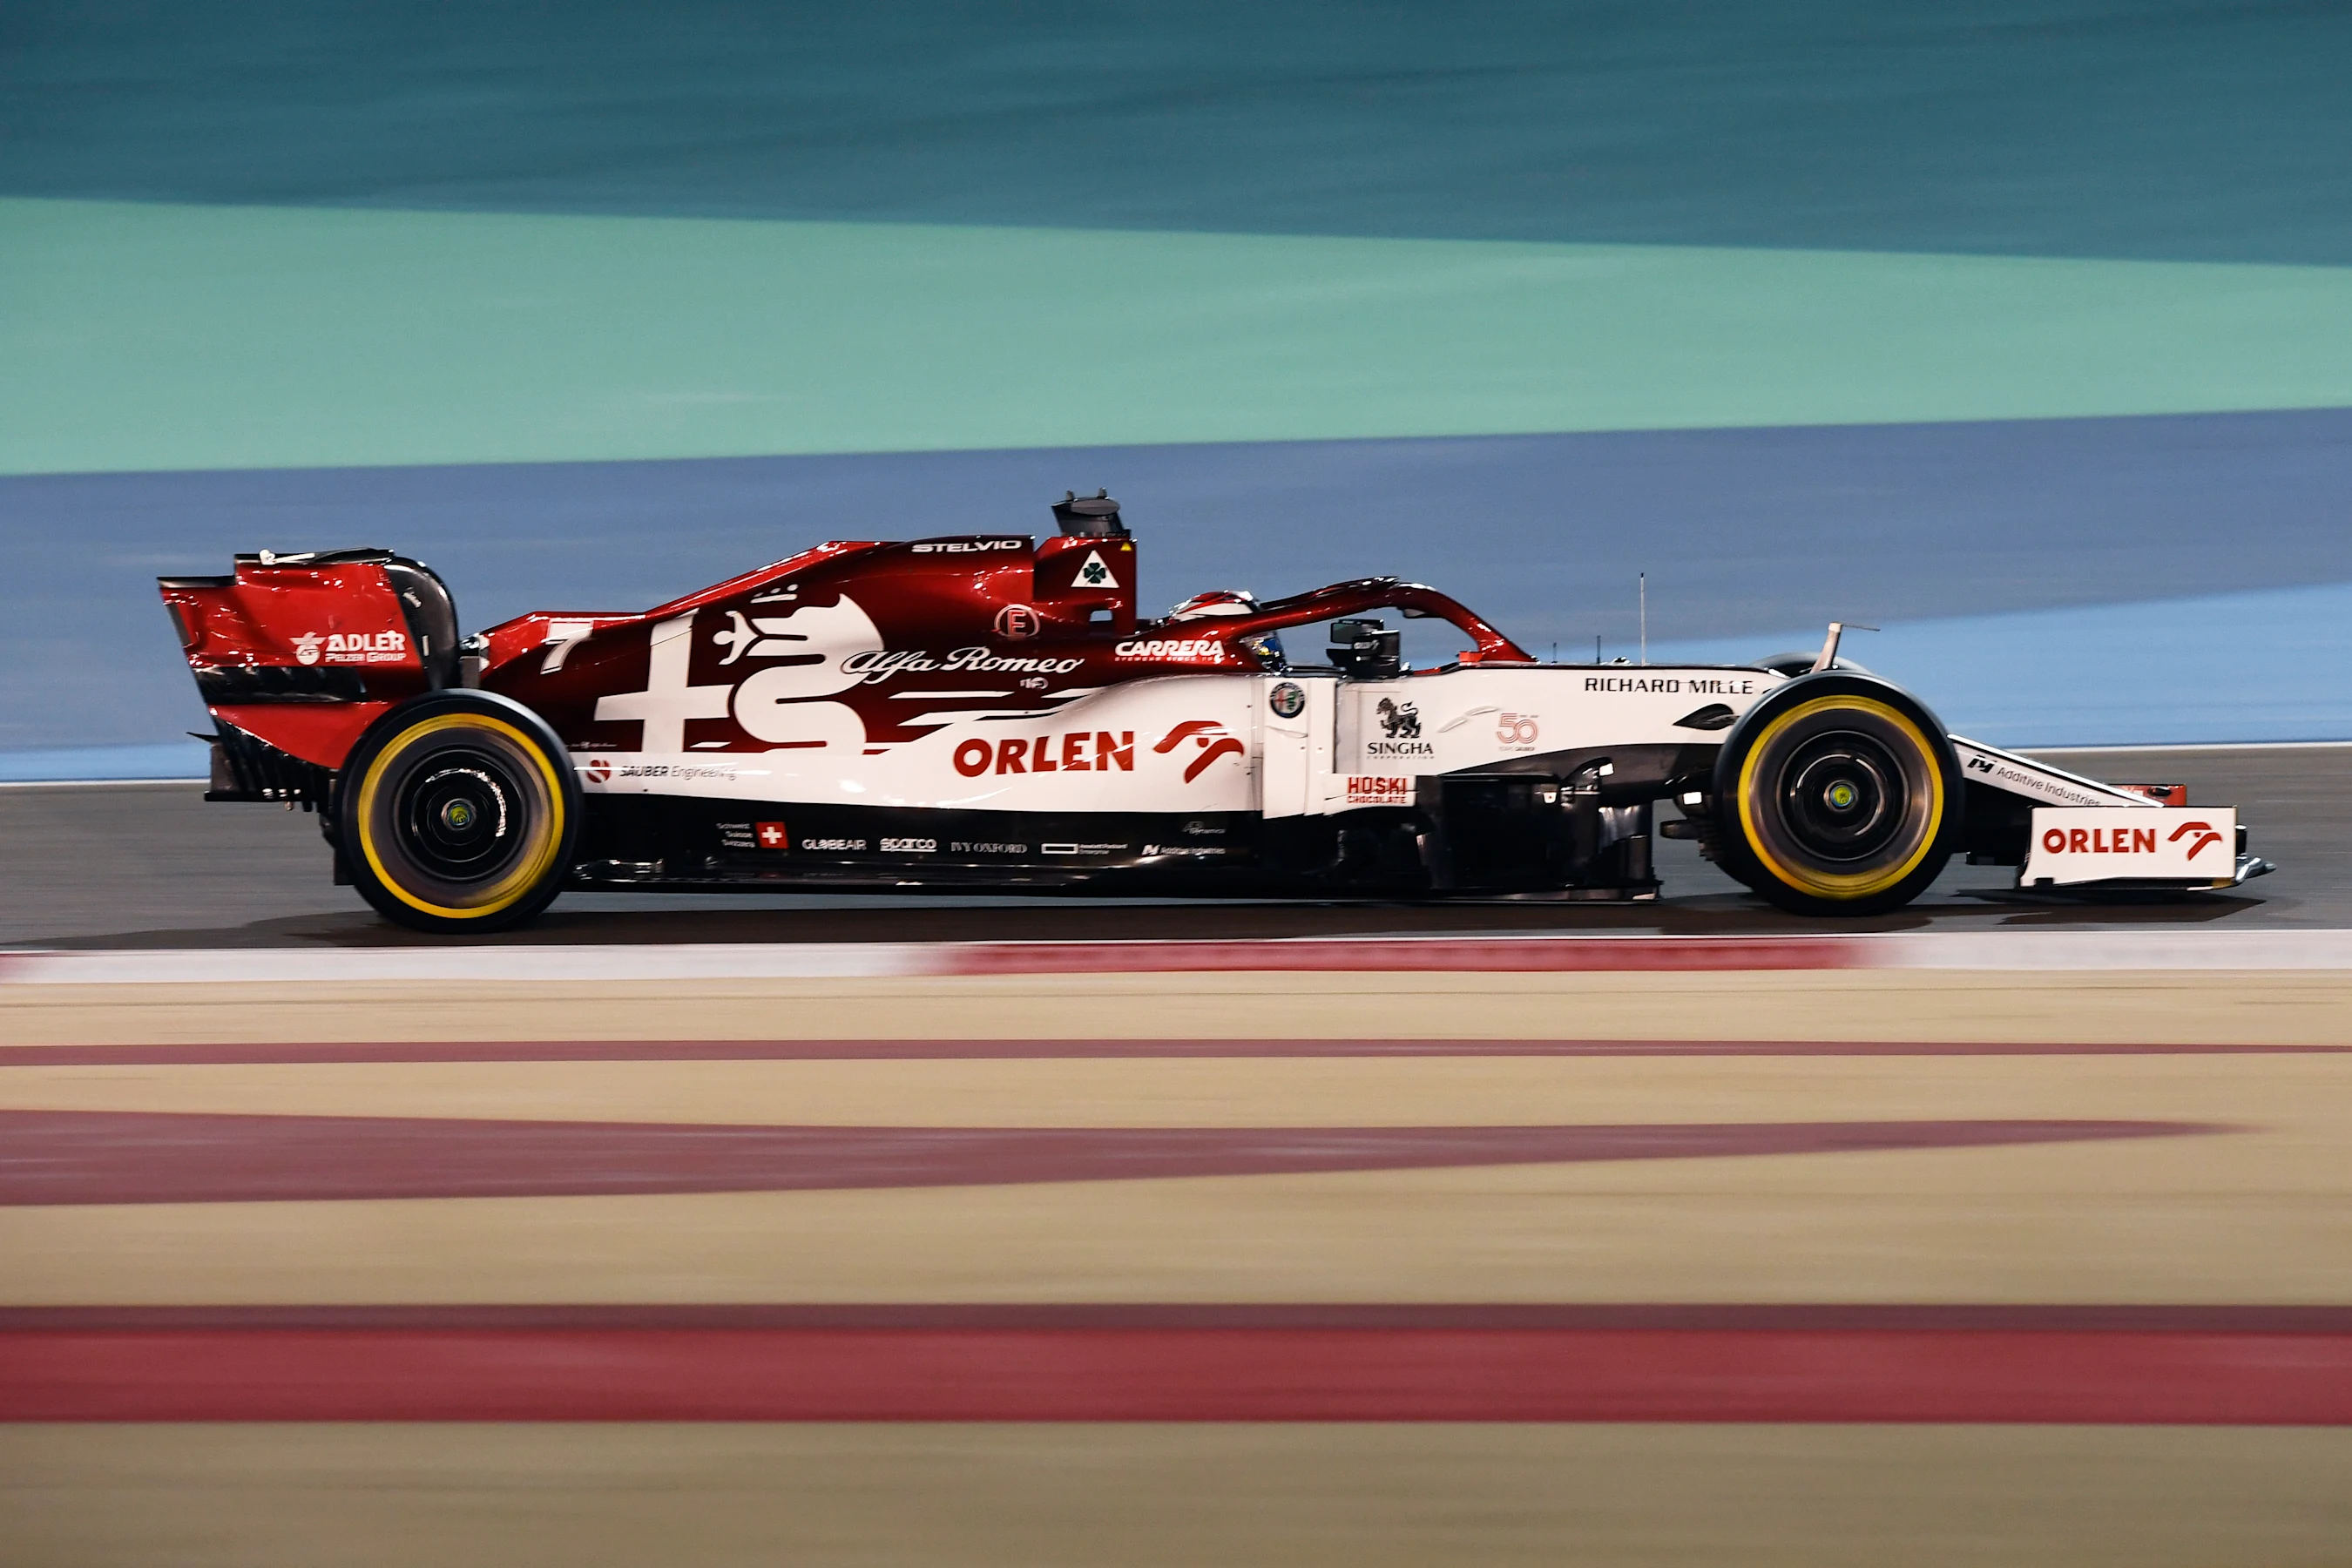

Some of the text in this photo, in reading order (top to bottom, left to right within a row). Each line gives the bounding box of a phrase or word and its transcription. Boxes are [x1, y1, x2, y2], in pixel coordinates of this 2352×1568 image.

[912, 540, 1022, 552] STELVIO
[326, 633, 406, 652] ADLER
[540, 618, 594, 674] 7
[1115, 640, 1225, 657] CARRERA
[841, 646, 1085, 684] Alfa Romeo
[1585, 678, 1753, 694] RICHARD MILLE
[1496, 713, 1538, 744] 50
[953, 731, 1135, 778] ORLEN
[1367, 742, 1434, 754] SINGHA
[619, 767, 669, 777] SAUBER
[1997, 767, 2101, 807] Additive Industries
[880, 838, 937, 852] sparco
[2042, 828, 2157, 854] ORLEN
